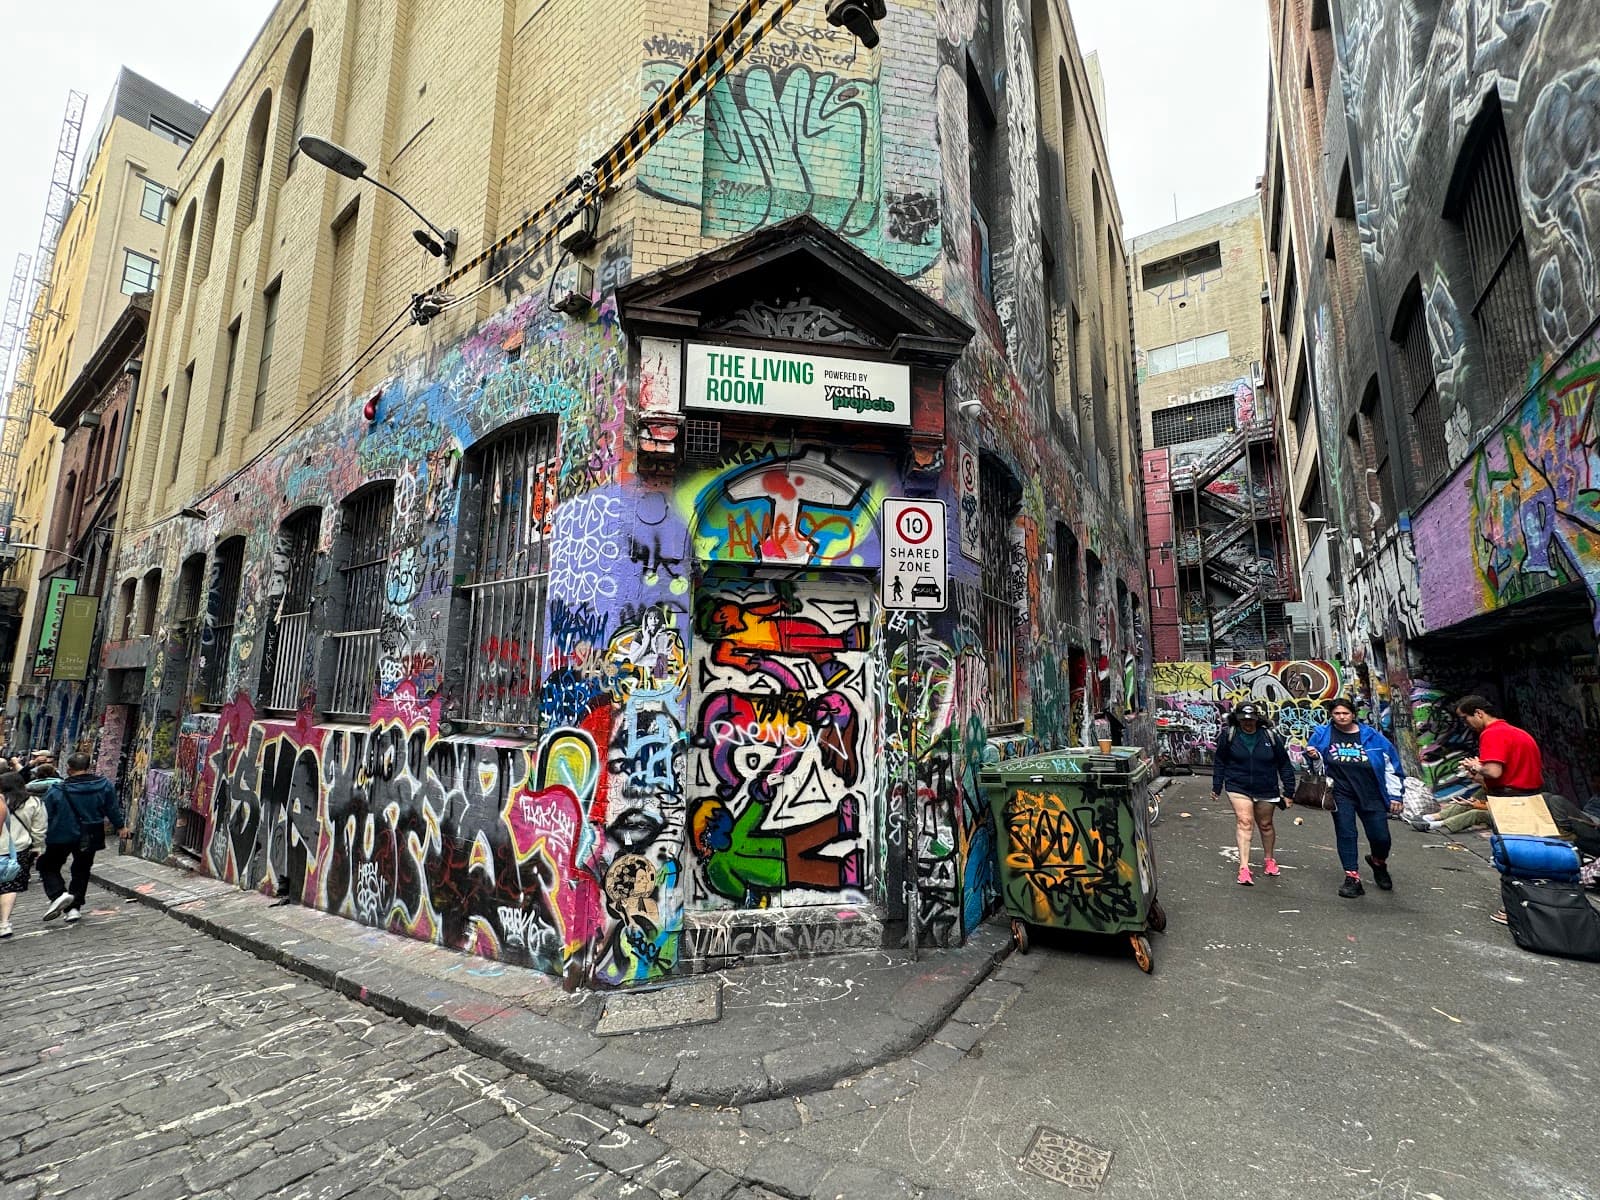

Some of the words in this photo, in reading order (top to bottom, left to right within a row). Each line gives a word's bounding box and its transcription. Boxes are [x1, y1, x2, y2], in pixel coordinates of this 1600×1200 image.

[707, 352, 744, 379] THE
[751, 358, 814, 385] LIVING
[824, 369, 857, 381] POWERED
[858, 373, 868, 382] BY
[706, 379, 764, 405] ROOM
[824, 384, 871, 401] youth
[833, 397, 895, 413] projects
[905, 517, 923, 534] 10
[890, 547, 939, 559] SHARED
[898, 561, 931, 573] ZONE
